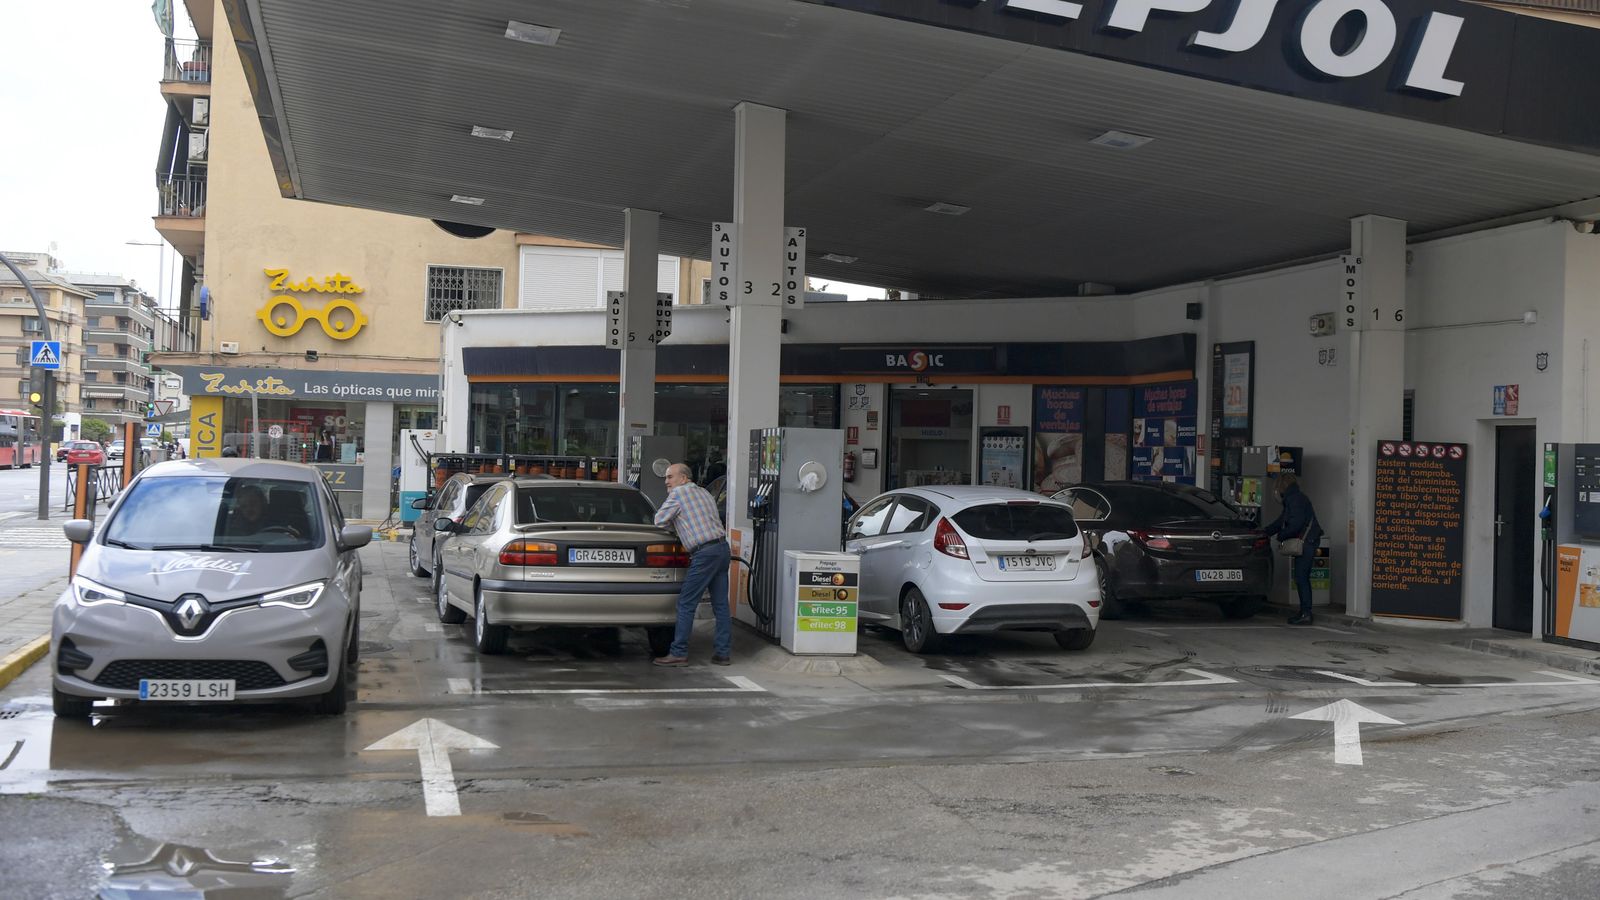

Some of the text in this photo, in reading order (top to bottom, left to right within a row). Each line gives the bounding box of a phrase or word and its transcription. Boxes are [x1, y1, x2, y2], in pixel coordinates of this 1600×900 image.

[720, 233, 730, 300] AUTOS
[787, 238, 798, 304] AUTOS
[264, 268, 365, 294] Zurita
[744, 281, 781, 296] 3 2
[1345, 265, 1356, 327] MOTOS
[1372, 308, 1403, 322] 1 6
[612, 299, 620, 345] AUTOS
[628, 332, 655, 343] 5 4
[886, 352, 944, 369] BASIC
[200, 373, 440, 400] Zurita Las ópticas que mir
[1041, 390, 1080, 400] Muchas
[1046, 400, 1074, 409] horas
[1377, 459, 1443, 469] Existen medidas
[1397, 485, 1460, 495] establecimiento
[1437, 494, 1458, 503] hojas
[1392, 517, 1439, 526] consumidor
[1443, 521, 1458, 529] que
[1392, 534, 1431, 542] surtidores
[1428, 543, 1445, 551] sido
[1374, 549, 1417, 558] legalmente
[1006, 557, 1052, 567] 1519 JVC
[1410, 559, 1446, 568] disponen
[1385, 566, 1417, 574] etiqueta
[1201, 571, 1240, 580] 0428 JBG
[149, 683, 228, 697] 2359 LSH
